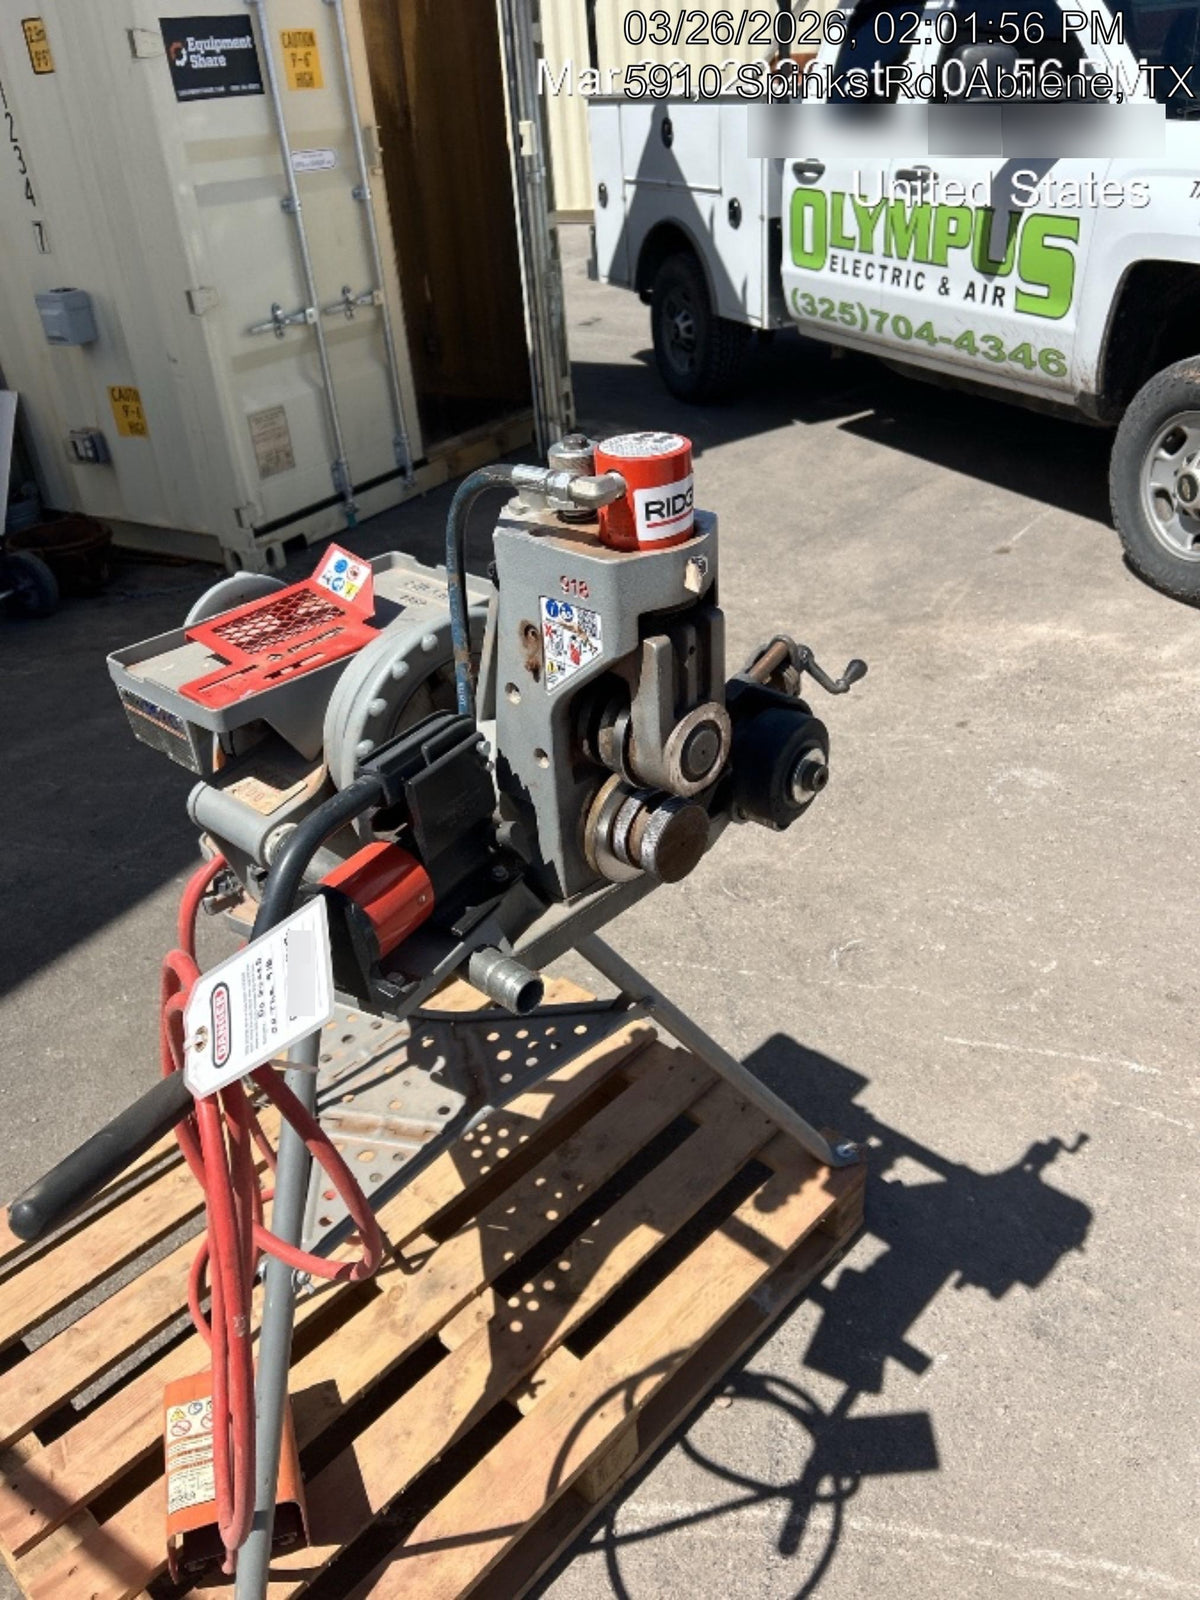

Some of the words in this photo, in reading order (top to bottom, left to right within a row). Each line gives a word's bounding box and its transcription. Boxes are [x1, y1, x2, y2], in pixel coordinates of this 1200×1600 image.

[186, 36, 252, 54] Equipment
[189, 54, 227, 69] Share
[790, 186, 1081, 321] OLYMPUS
[829, 254, 926, 292] ELECTRIC
[938, 278, 951, 297] &
[963, 280, 1007, 308] AIR
[790, 286, 1068, 377] (325)704-4346
[560, 575, 589, 599] 918
